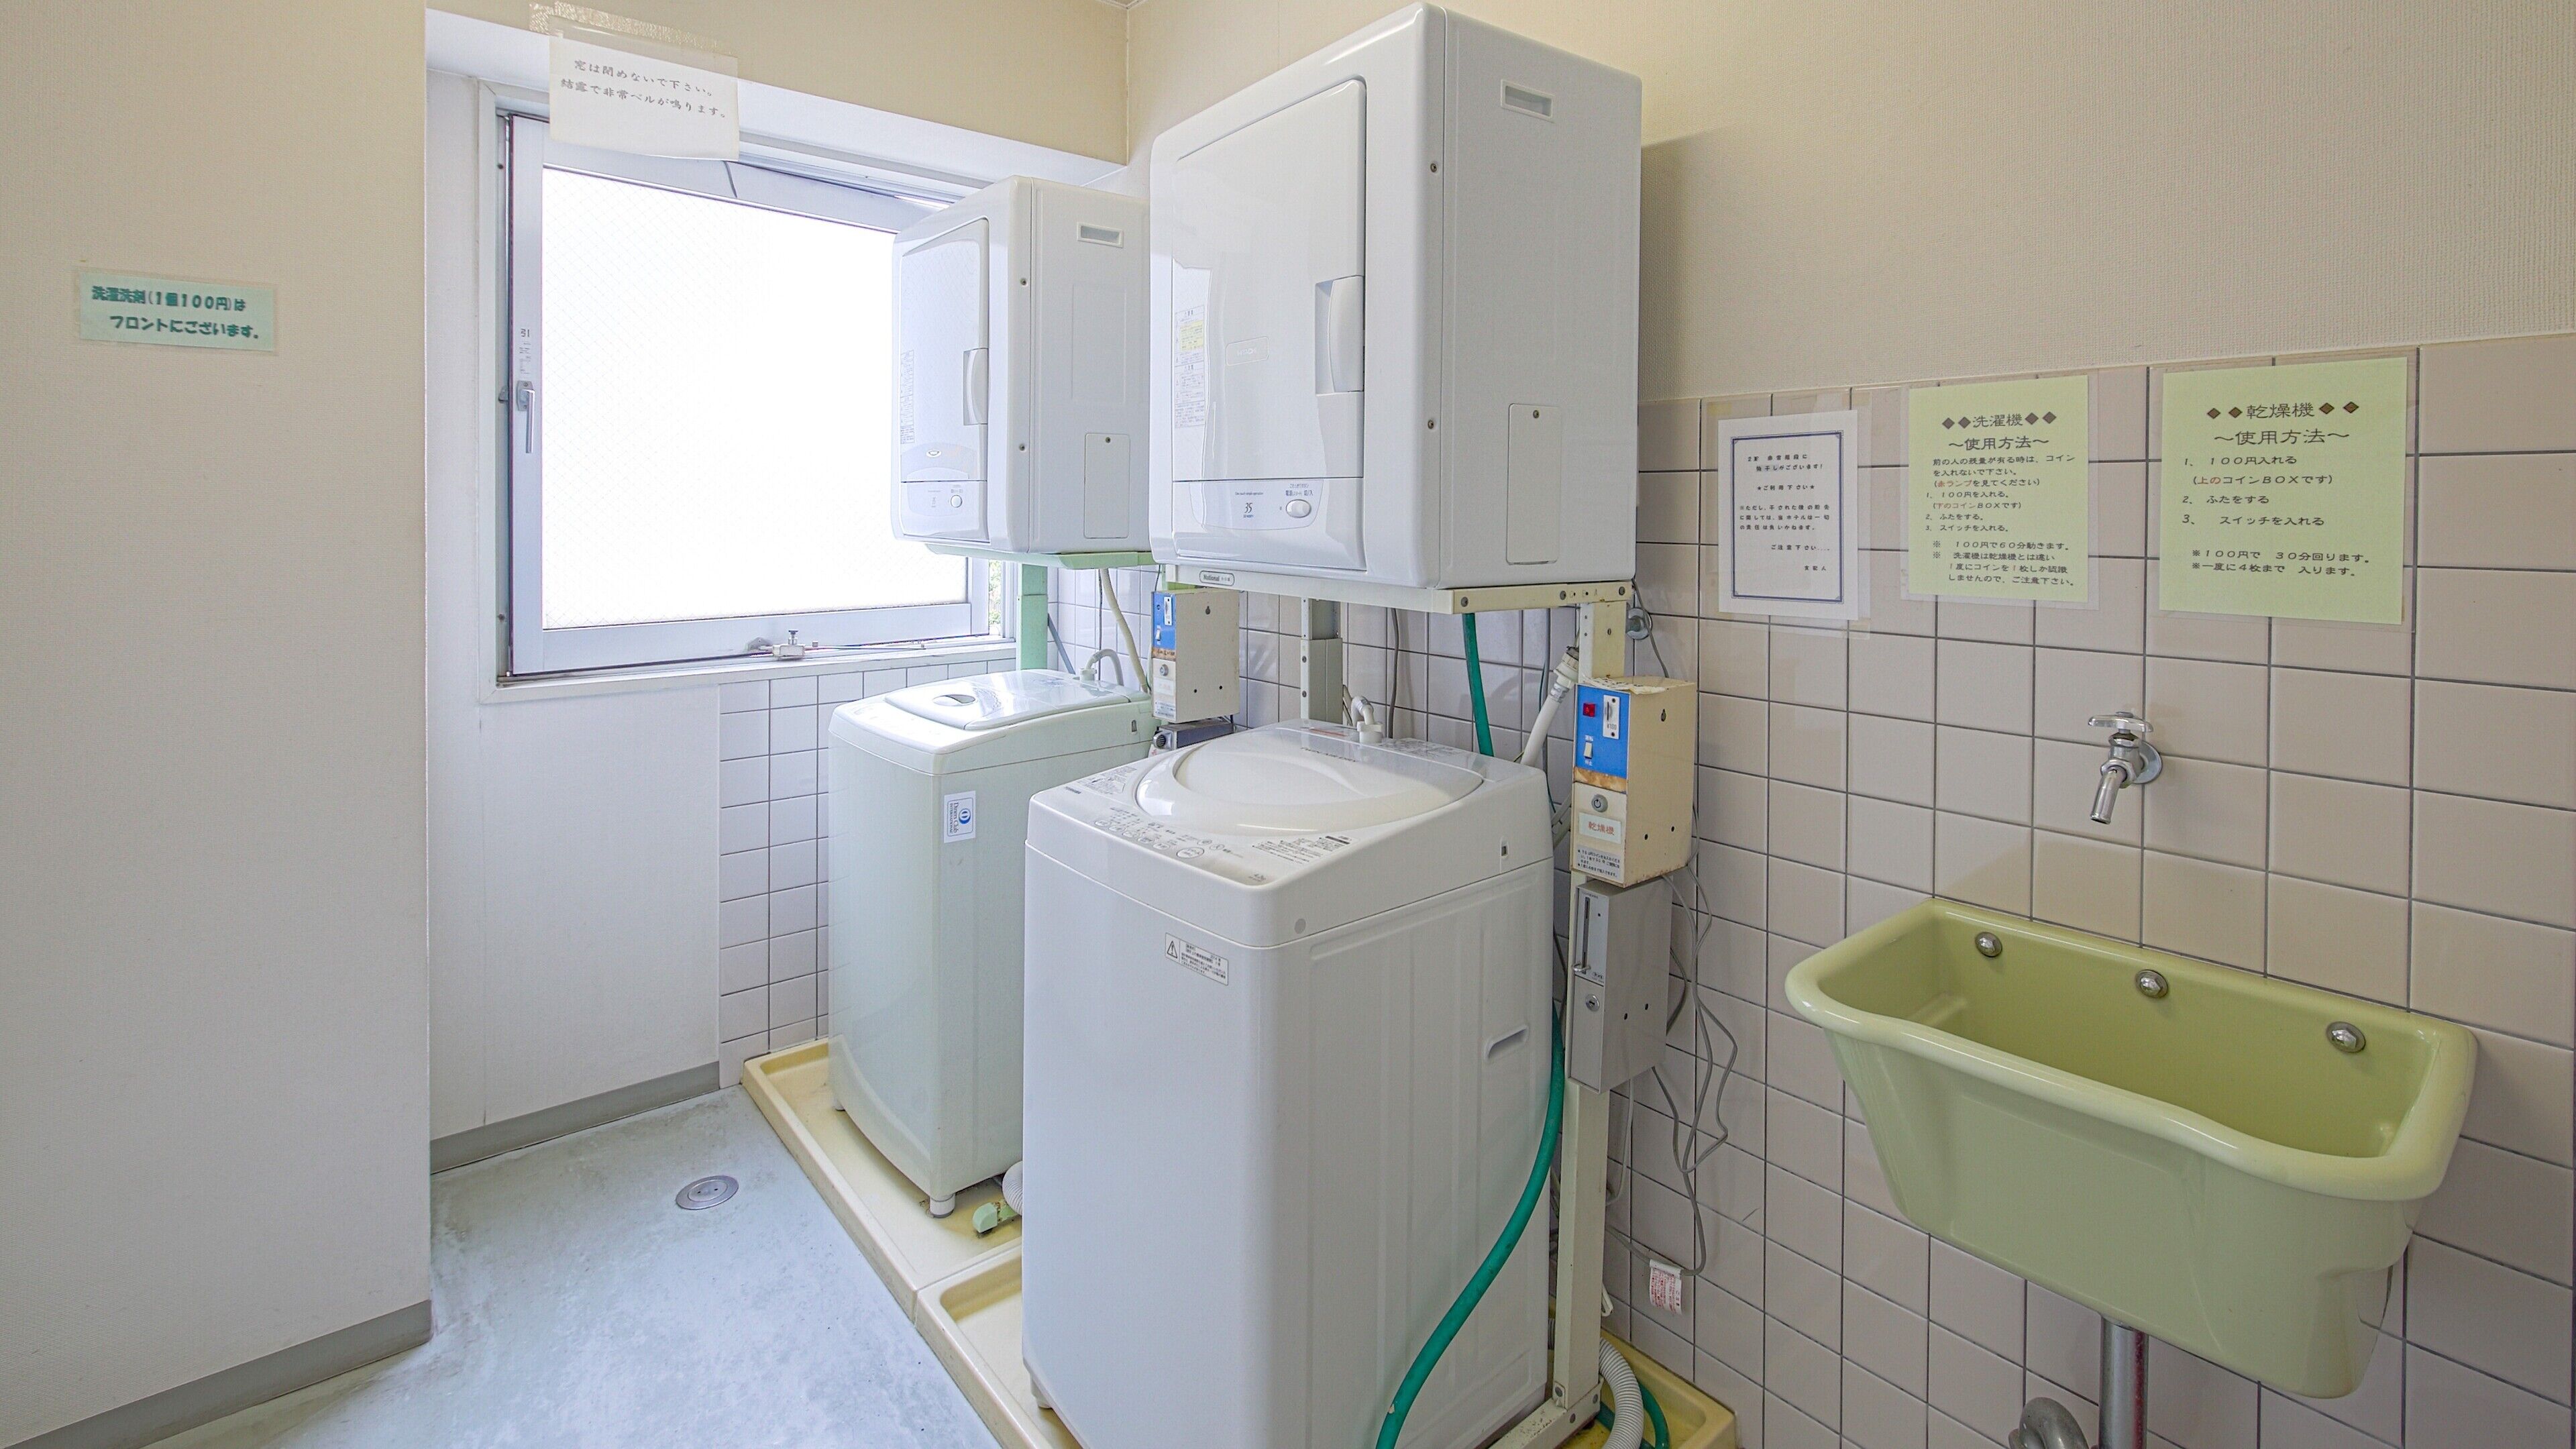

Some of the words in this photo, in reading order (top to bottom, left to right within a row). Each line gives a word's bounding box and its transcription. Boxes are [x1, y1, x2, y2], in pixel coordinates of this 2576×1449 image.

[110, 315, 259, 339] フロントにございます。
[1244, 502, 1252, 513] 35
